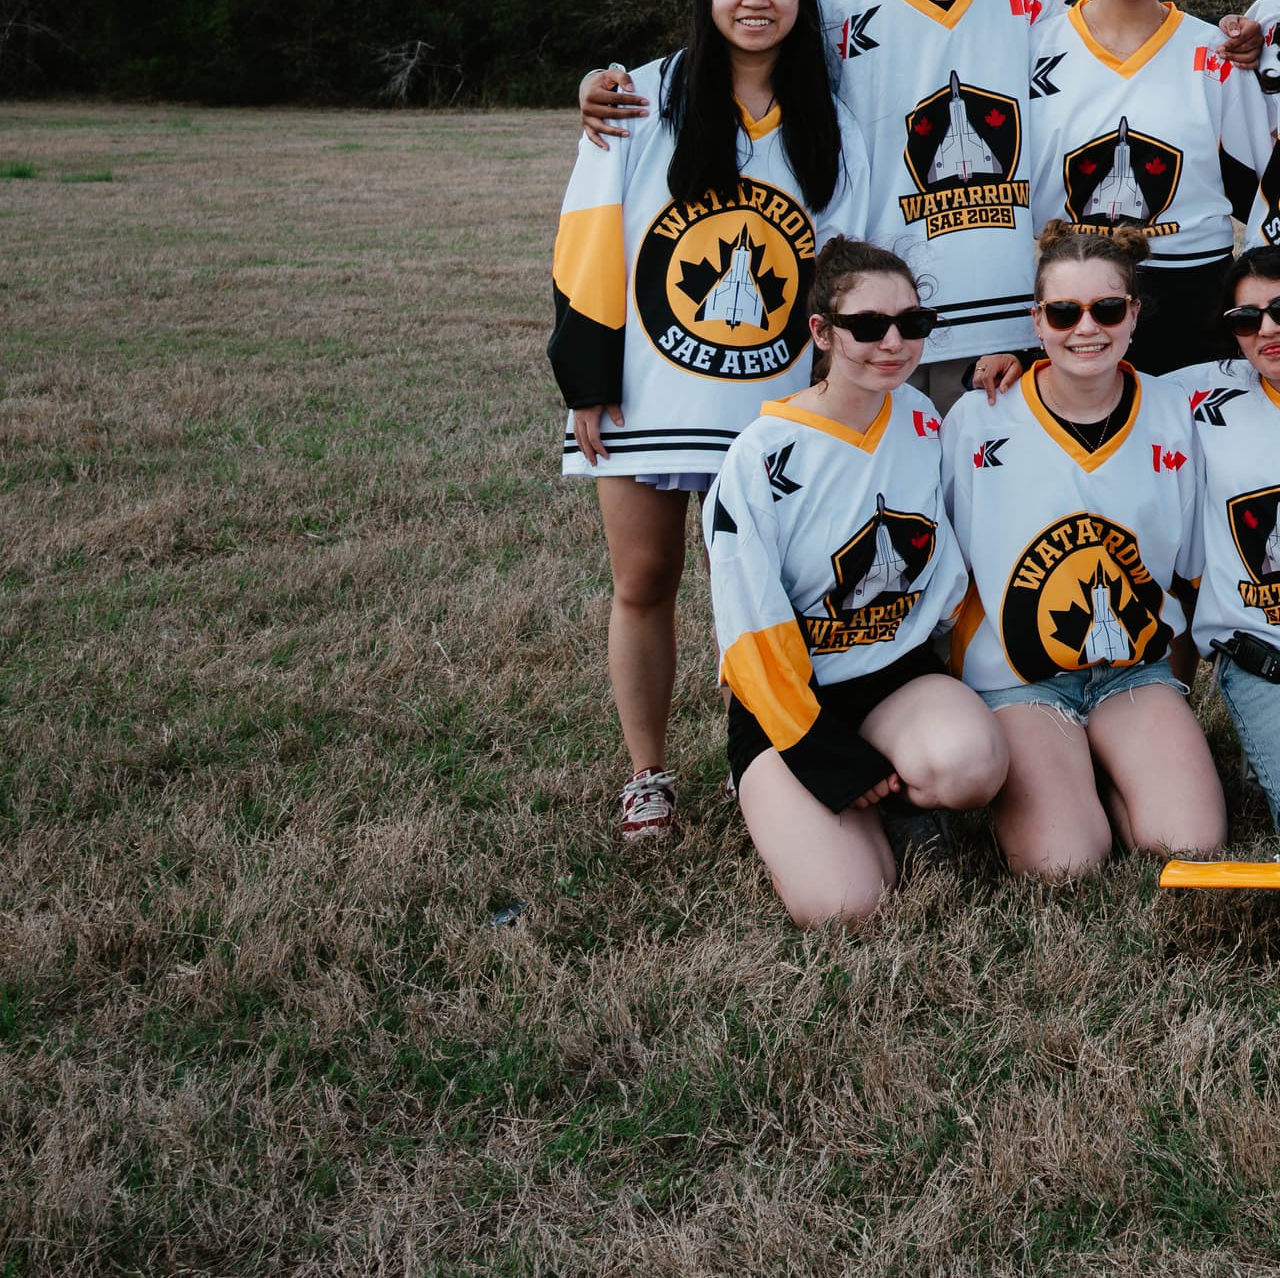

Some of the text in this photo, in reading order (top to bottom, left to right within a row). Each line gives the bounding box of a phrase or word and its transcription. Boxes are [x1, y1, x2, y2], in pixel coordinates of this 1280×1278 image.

[901, 183, 1028, 222] WATARROW
[930, 208, 1011, 234] SAE 2025
[658, 325, 790, 374] SAE AERO
